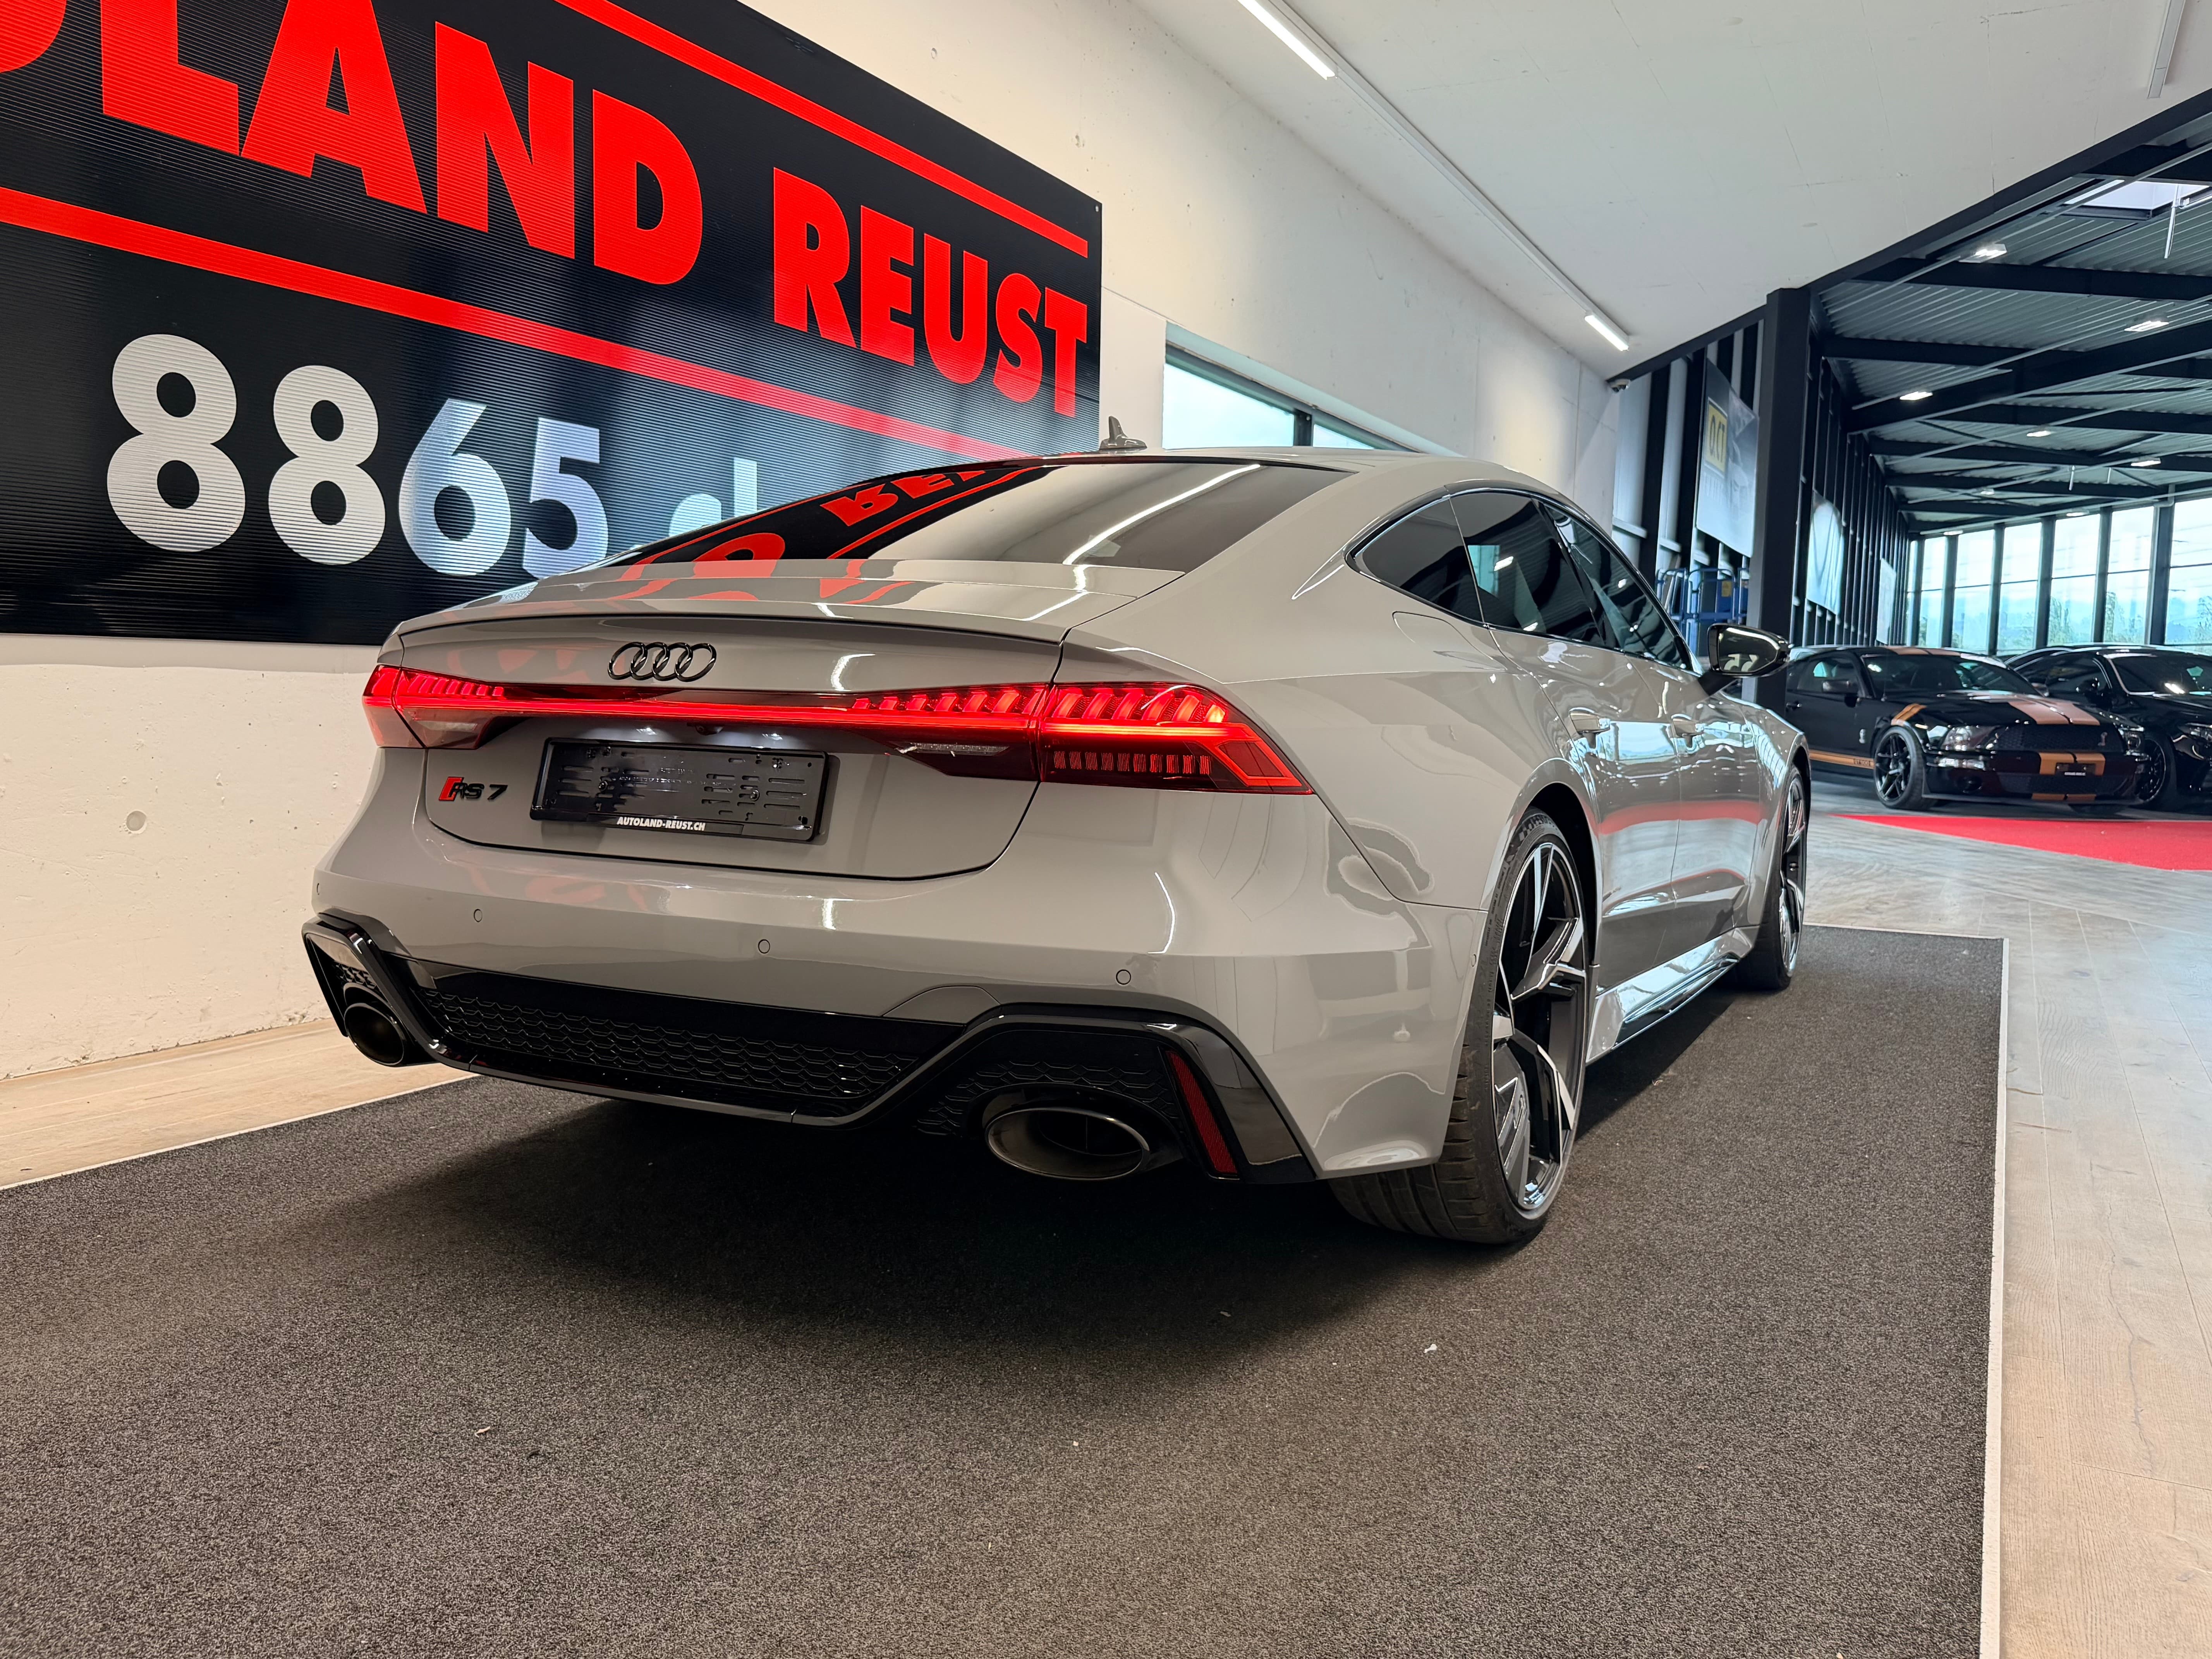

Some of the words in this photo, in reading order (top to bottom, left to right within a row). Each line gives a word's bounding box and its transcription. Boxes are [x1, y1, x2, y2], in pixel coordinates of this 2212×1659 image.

[774, 167, 1087, 417] REUST
[439, 776, 485, 801] RS
[487, 784, 508, 800] 7
[617, 816, 706, 831] AUTOLAND-REUST.CH
